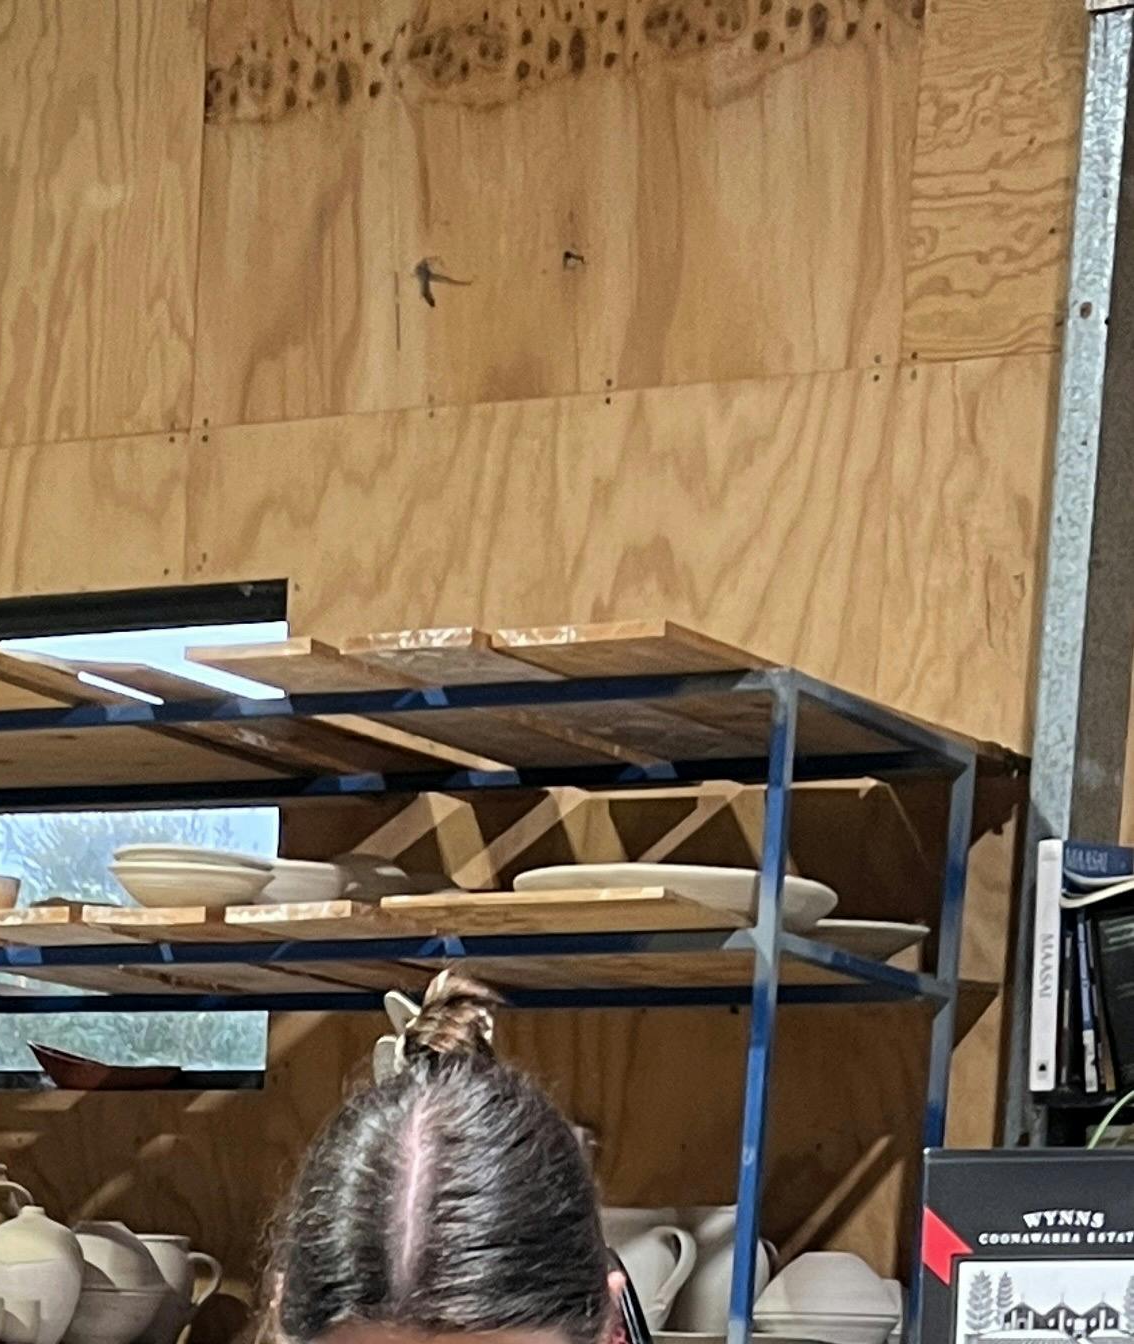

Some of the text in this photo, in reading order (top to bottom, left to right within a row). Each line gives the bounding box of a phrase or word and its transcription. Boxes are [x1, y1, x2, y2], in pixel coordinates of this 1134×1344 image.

[1038, 933, 1054, 1000] MAASAI
[1022, 1208, 1105, 1229] WYNNS
[977, 1231, 1081, 1246] COONAWARRA
